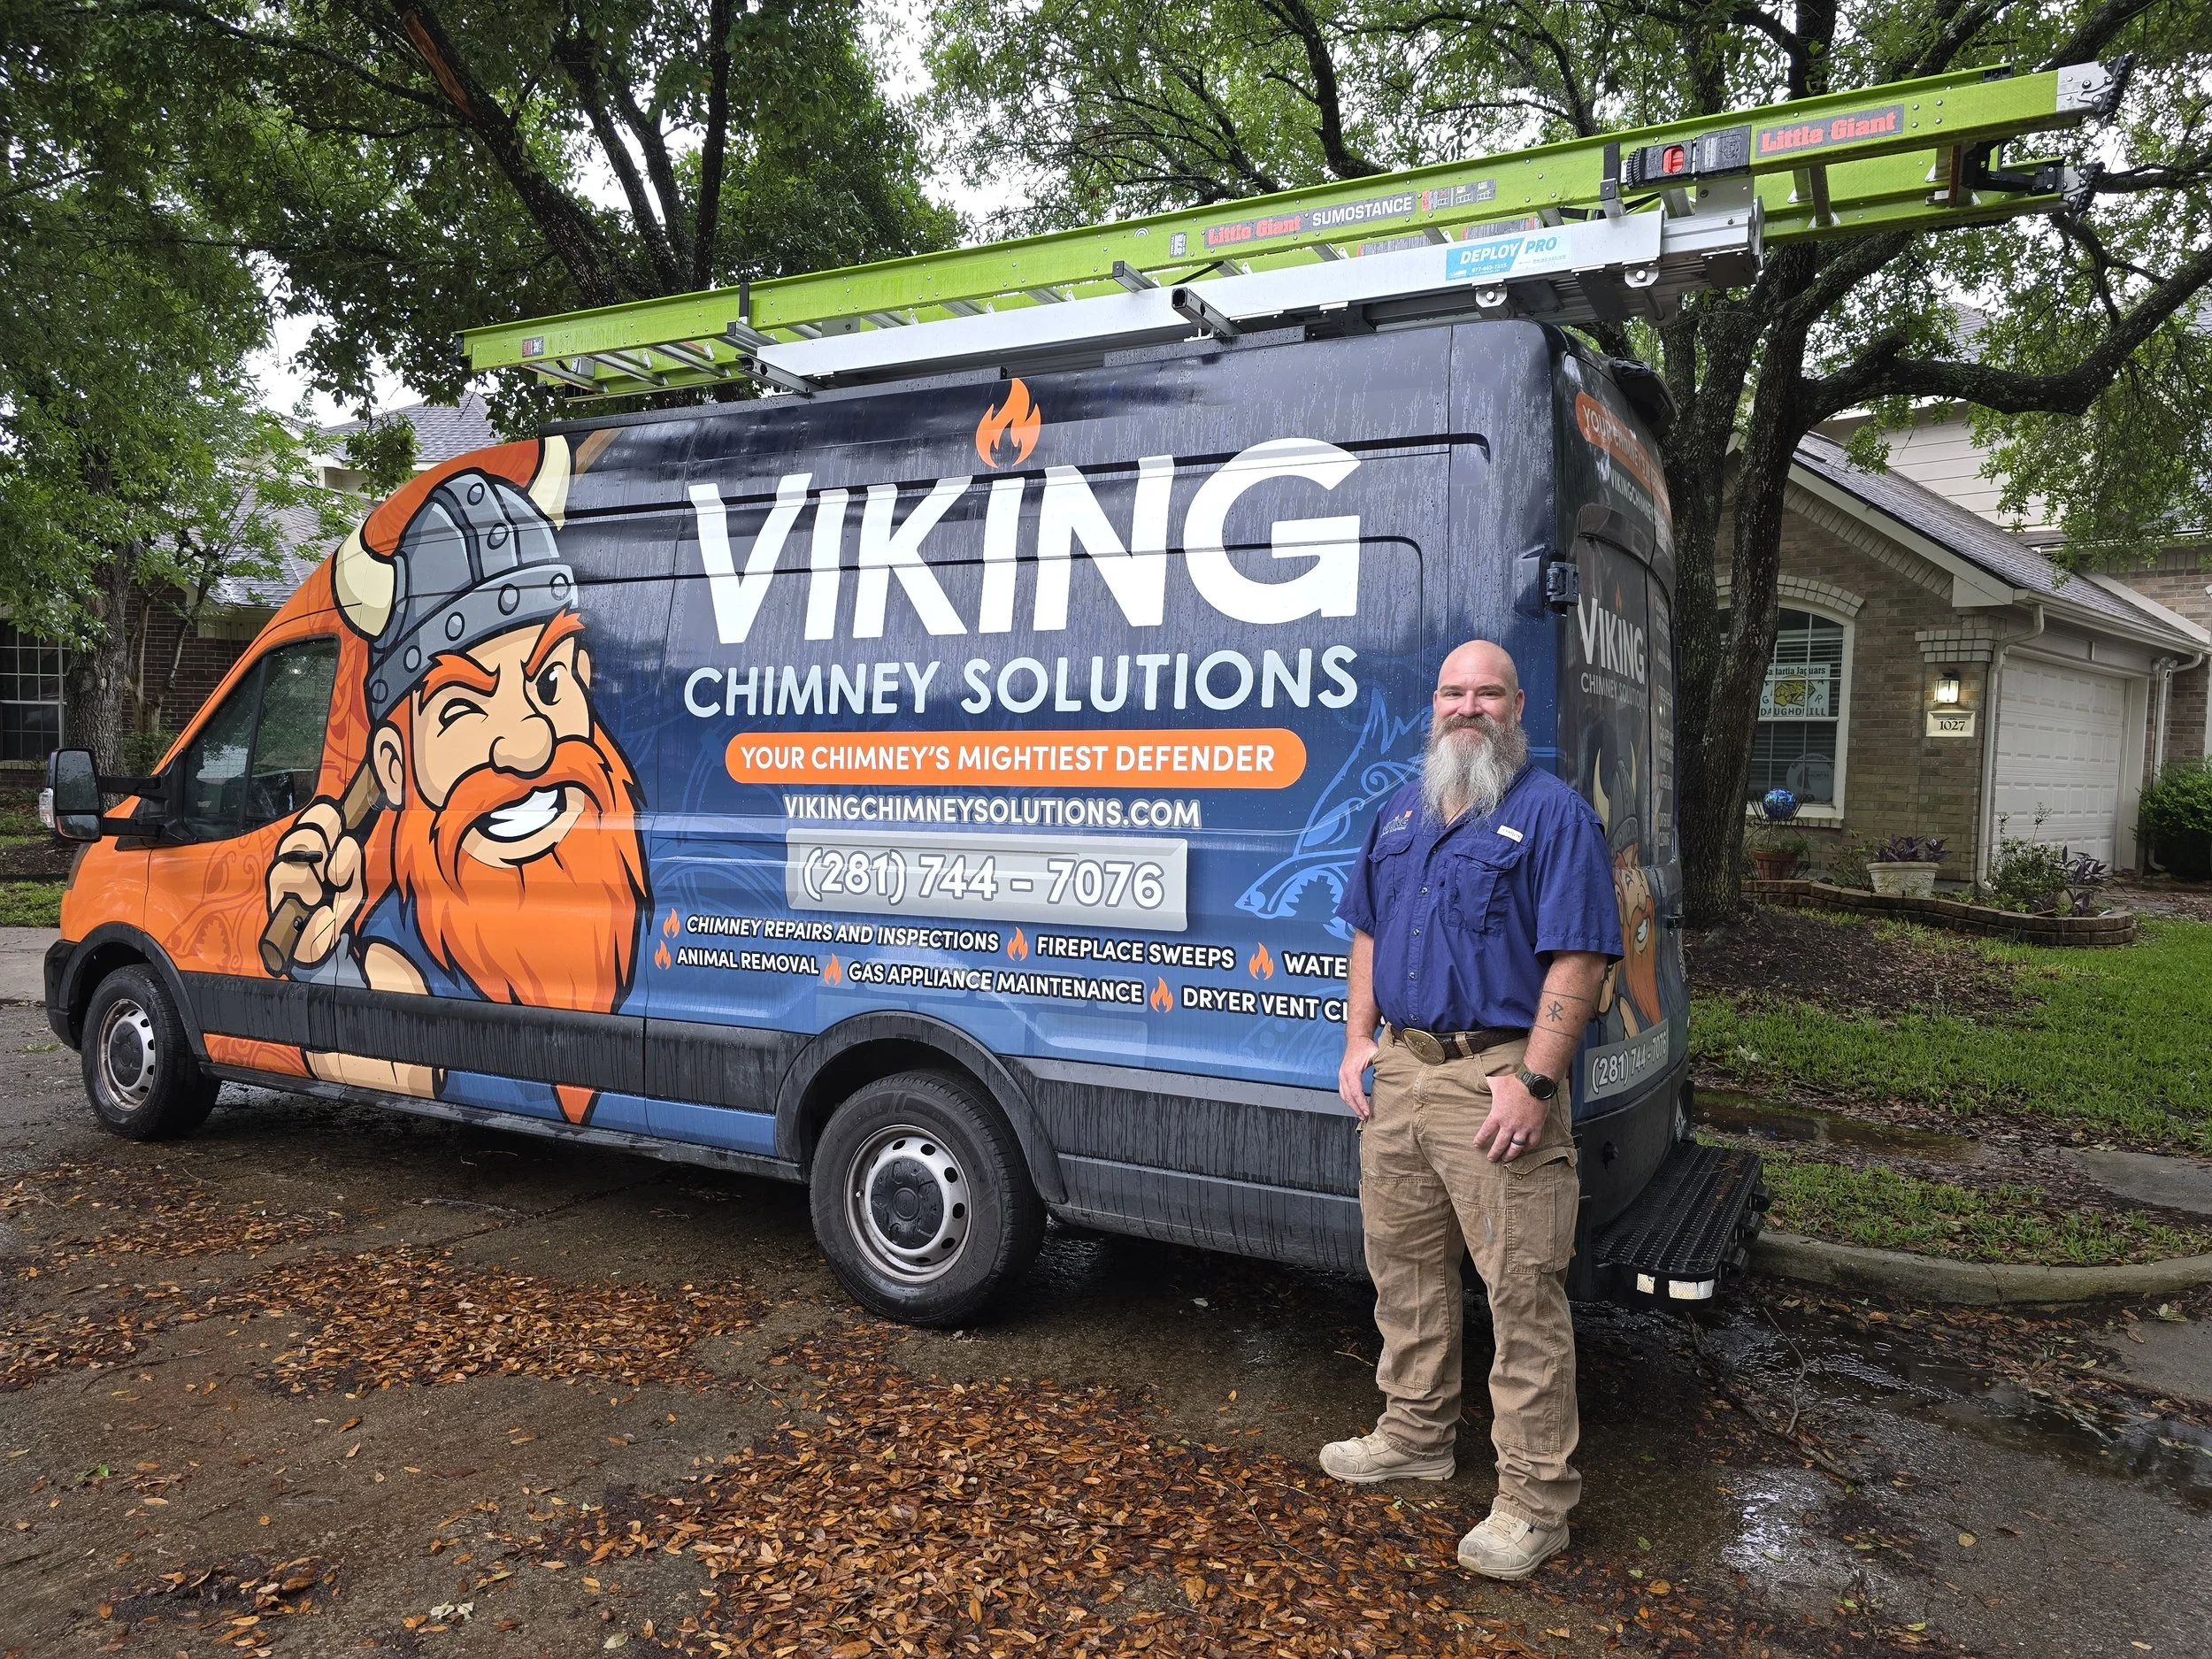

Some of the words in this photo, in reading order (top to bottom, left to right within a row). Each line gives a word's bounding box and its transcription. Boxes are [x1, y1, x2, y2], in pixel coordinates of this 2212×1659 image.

[1761, 128, 1824, 152] Little
[1832, 111, 1896, 141] Giant
[1208, 225, 1251, 245] Little
[1256, 215, 1301, 237] Giant
[1312, 196, 1412, 227] SUMOSTANCE
[1460, 242, 1521, 265] DEPLOY
[1525, 236, 1557, 254] PRO
[1582, 404, 1613, 442] YOUR
[688, 437, 1362, 644] VIKING
[1578, 593, 1645, 685] VIKING
[684, 660, 941, 718] CHIMNEY
[961, 644, 1359, 712] SOLUTIONS
[1581, 672, 1617, 699] CHIMNEY
[1939, 720, 1965, 731] 1027
[741, 746, 805, 770] YOUR
[811, 746, 950, 771] CHIMNEY'S
[957, 745, 1108, 772] MIGHTIEST
[1116, 744, 1275, 772] DEFENDER
[783, 794, 1202, 828] VIKINGCHIMNEYSOLUTIONS.COM
[803, 847, 907, 905] (281)
[918, 855, 998, 900] 744
[1047, 858, 1164, 909] 7076
[687, 916, 763, 937] CHIMNEY
[764, 921, 834, 941] REPAIRS
[835, 925, 873, 944] AND
[877, 927, 1000, 951] INSPECTIONS
[1037, 936, 1144, 962] FIREPLACE
[1149, 941, 1234, 969] SWEEPS
[1284, 952, 1352, 978] WATE
[677, 948, 740, 969] ANIMAL
[741, 952, 819, 974] REMOVAL
[849, 963, 884, 983] GAS
[887, 965, 993, 990] APPLIANCE
[996, 972, 1143, 1003] MAINTENANCE
[1184, 987, 1256, 1013] DRYER
[1261, 994, 1319, 1018] VENT
[1592, 1049, 1629, 1094] (281)
[1631, 1042, 1646, 1075] 744
[1652, 1030, 1667, 1063] 7076
